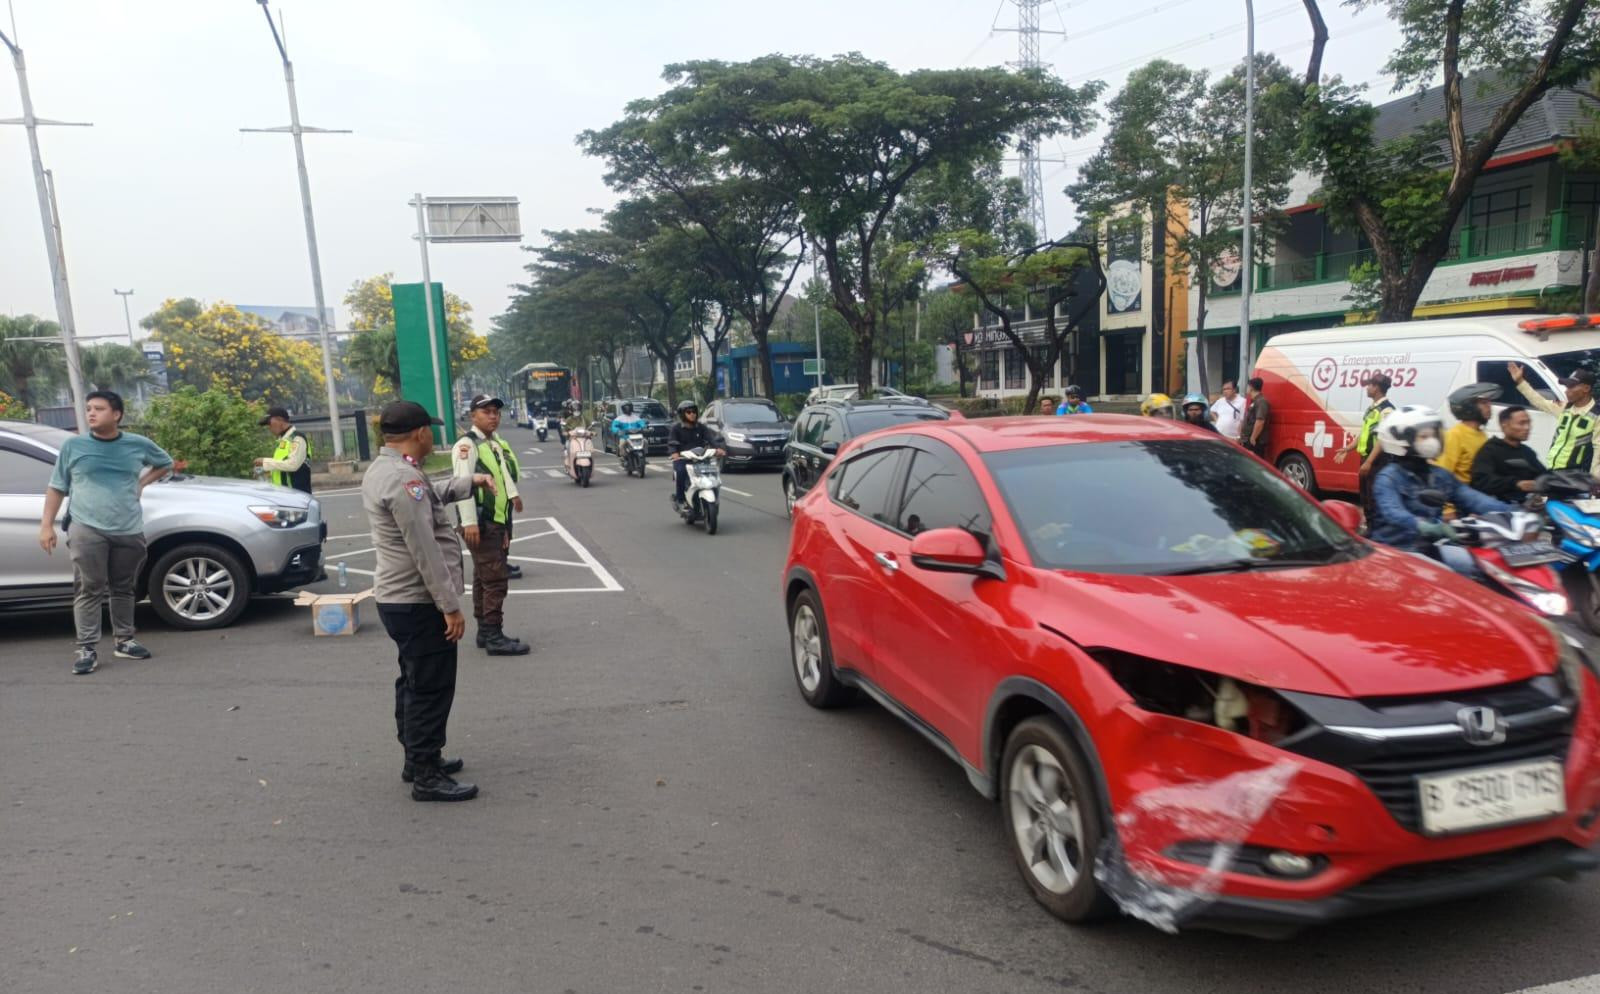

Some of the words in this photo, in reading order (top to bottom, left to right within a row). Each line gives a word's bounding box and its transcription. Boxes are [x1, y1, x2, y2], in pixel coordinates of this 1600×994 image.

[1343, 355, 1392, 367] Emergency
[1393, 352, 1411, 365] call
[1424, 783, 1444, 813] B
[1452, 773, 1513, 808] 2500
